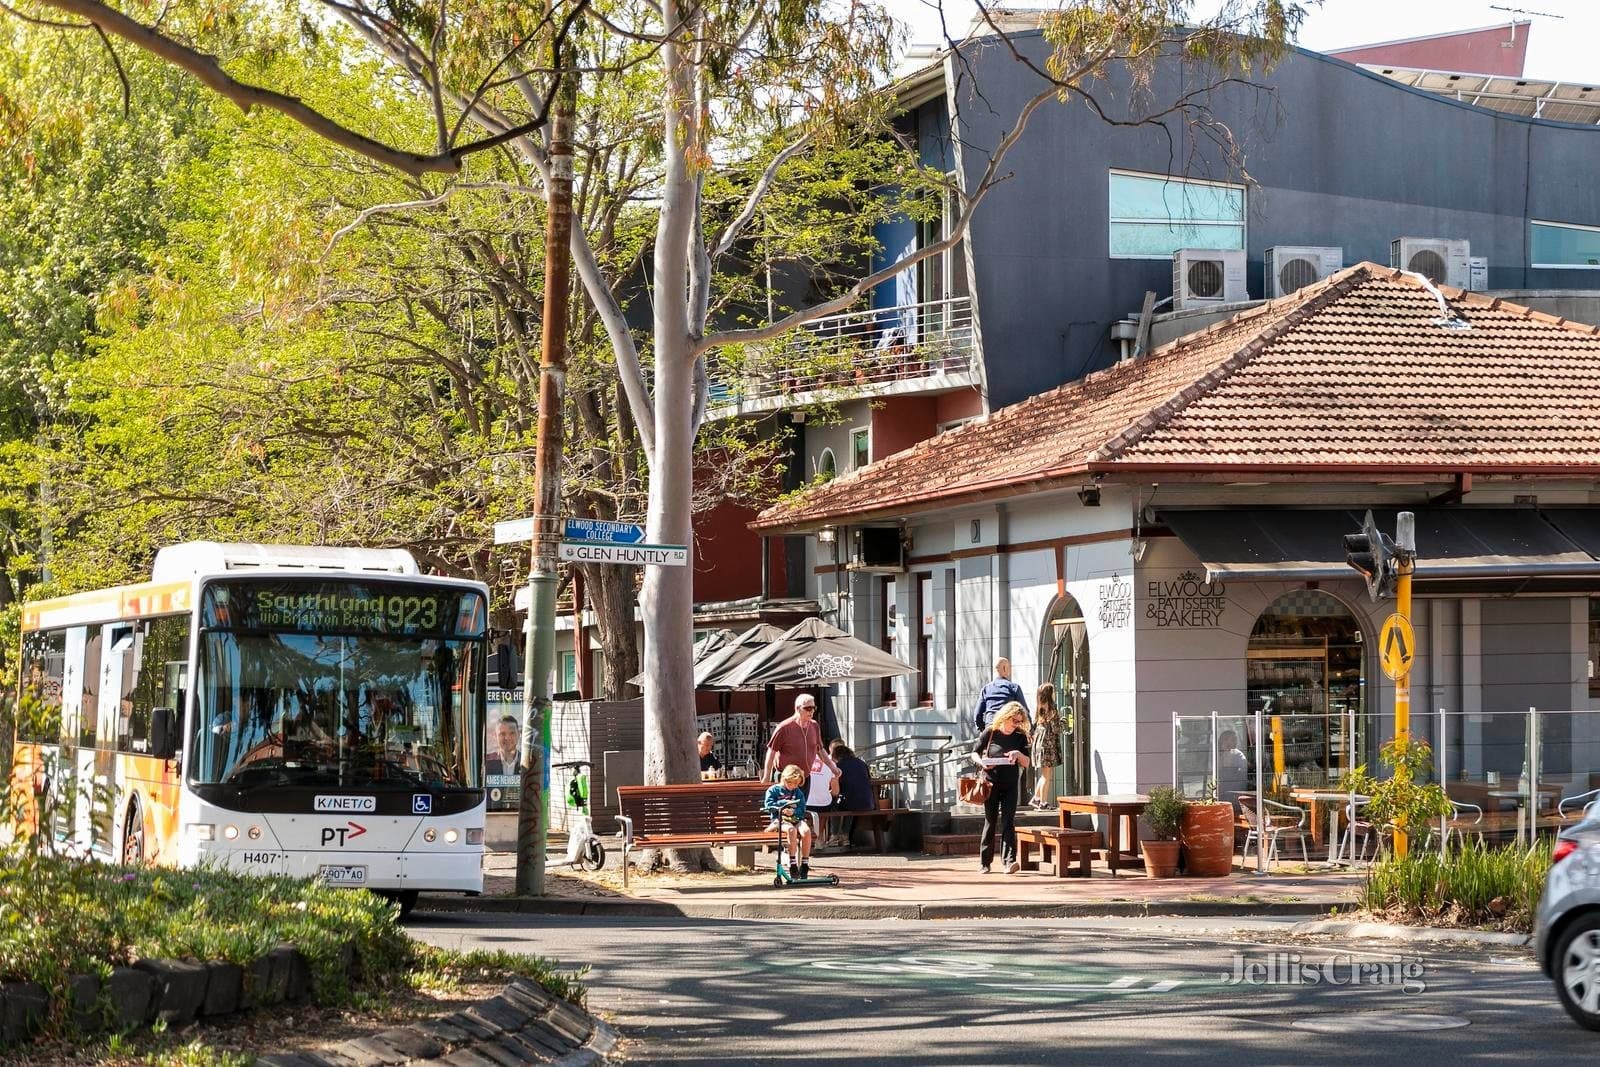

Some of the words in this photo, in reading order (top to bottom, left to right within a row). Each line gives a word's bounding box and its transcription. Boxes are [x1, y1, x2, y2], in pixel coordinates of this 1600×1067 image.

[568, 519, 594, 531] ELWOOD
[595, 521, 633, 534] SECONDARY
[586, 530, 614, 541] COLLEGE
[577, 547, 611, 560] GLEN
[617, 550, 670, 563] HUNTLY
[1148, 581, 1226, 598] ELWOOD
[256, 591, 384, 612] Southland
[387, 595, 438, 629] 923
[1157, 597, 1226, 610] PATISSERIE
[283, 610, 339, 626] Brighton
[342, 611, 382, 626] Beach
[487, 691, 500, 701] ERE
[501, 691, 512, 701] TO
[513, 691, 523, 701] HE
[243, 853, 277, 864] H407
